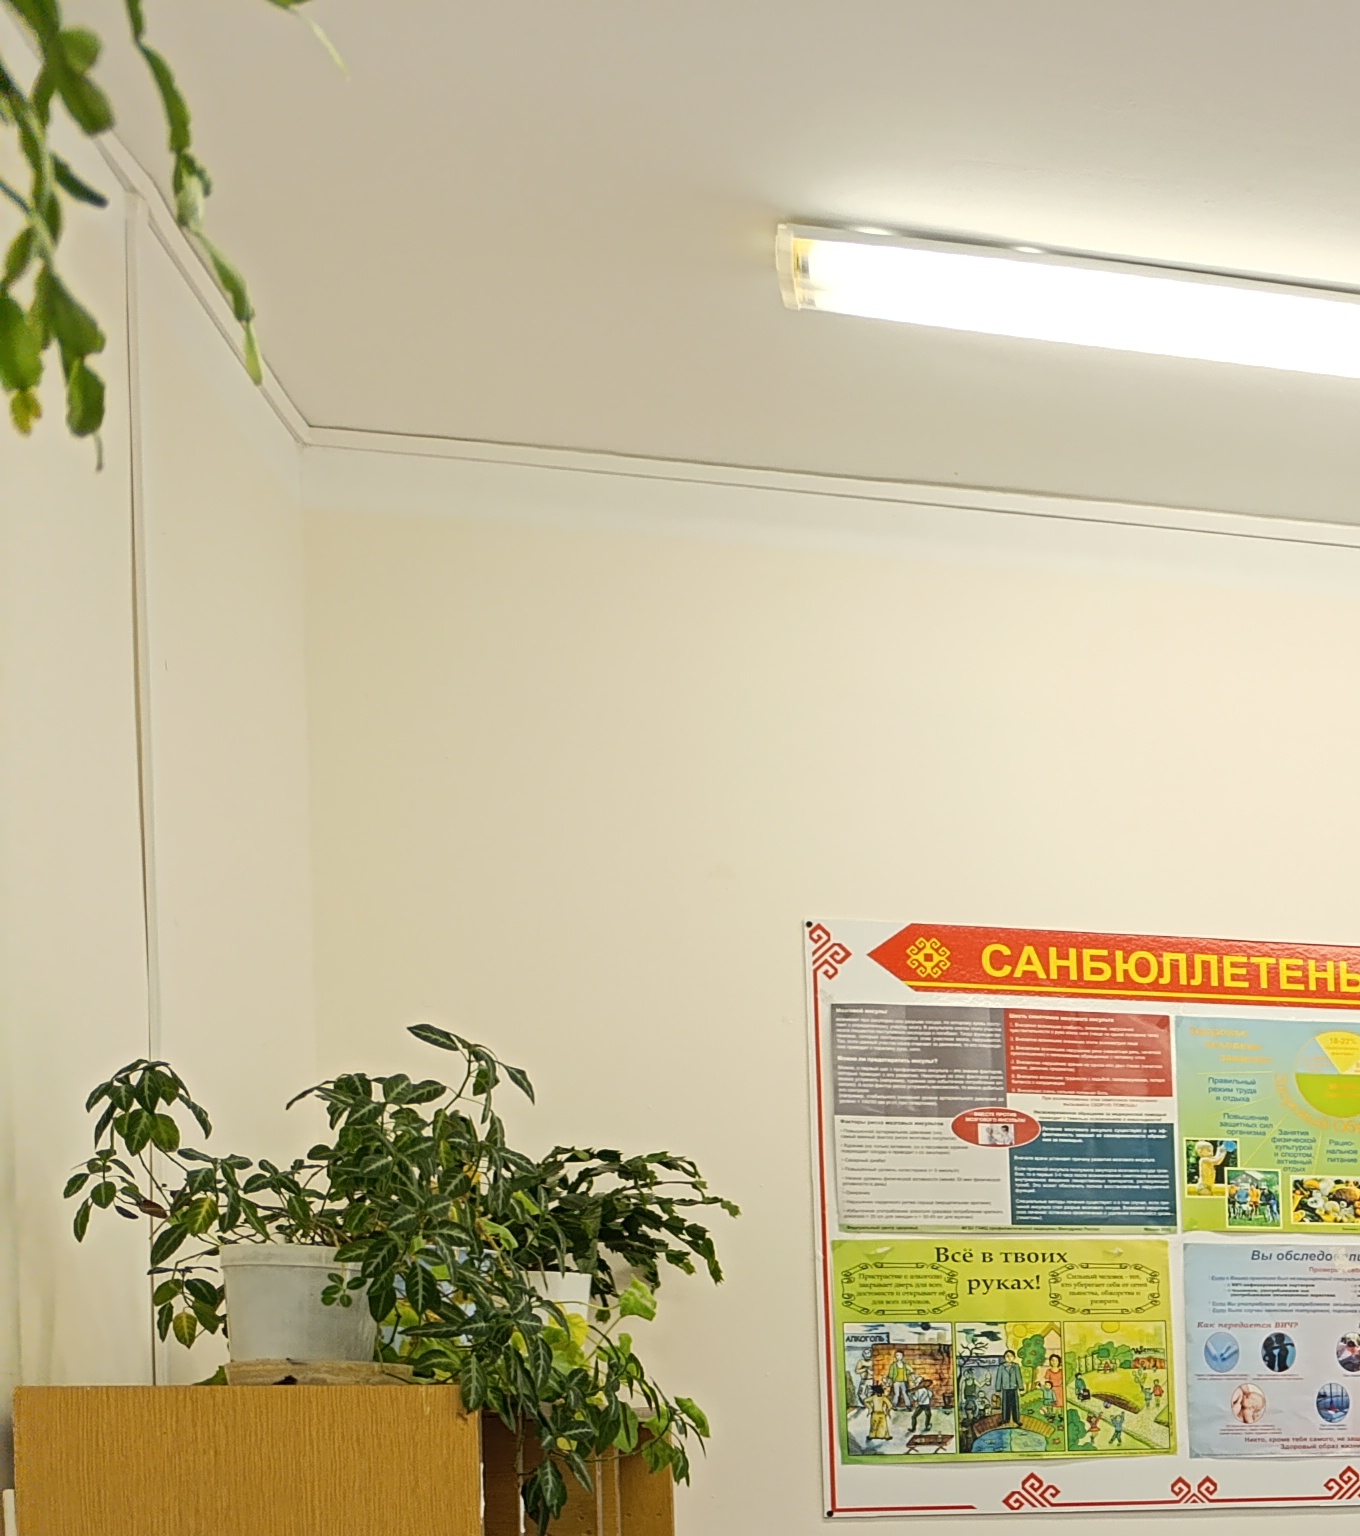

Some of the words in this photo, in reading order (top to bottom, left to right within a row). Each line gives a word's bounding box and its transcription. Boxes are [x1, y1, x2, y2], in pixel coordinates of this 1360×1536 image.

[1208, 1076, 1257, 1086] Правильный
[1235, 1087, 1257, 1095] труда
[934, 1246, 974, 1263] Всё
[980, 1251, 994, 1263] в
[1000, 1251, 1069, 1263] твоих
[1250, 1249, 1273, 1261] Вы
[966, 1274, 1041, 1296] руках!
[1197, 1321, 1215, 1329] Как
[1217, 1321, 1272, 1330] передается
[1273, 1321, 1299, 1329] ВИЧ?
[845, 1334, 886, 1343] АЛКОГОЛЬ
